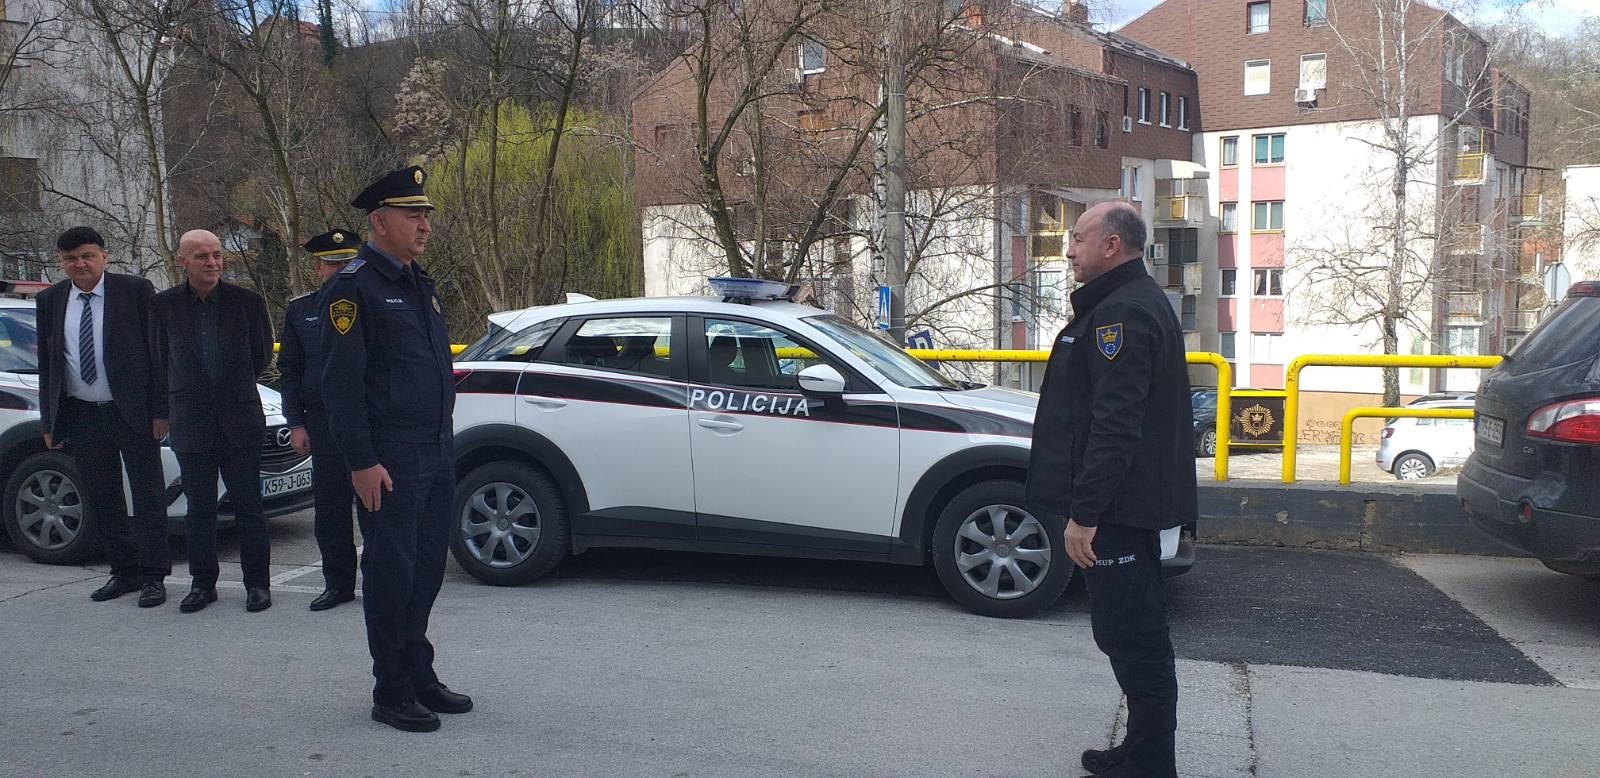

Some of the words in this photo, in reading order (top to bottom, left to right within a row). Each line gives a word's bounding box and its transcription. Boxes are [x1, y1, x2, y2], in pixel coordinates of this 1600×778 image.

[689, 388, 811, 417] POLICIJA
[264, 471, 311, 496] K59-J-063
[1095, 559, 1114, 567] MUP
[1118, 554, 1136, 565] ZDK
